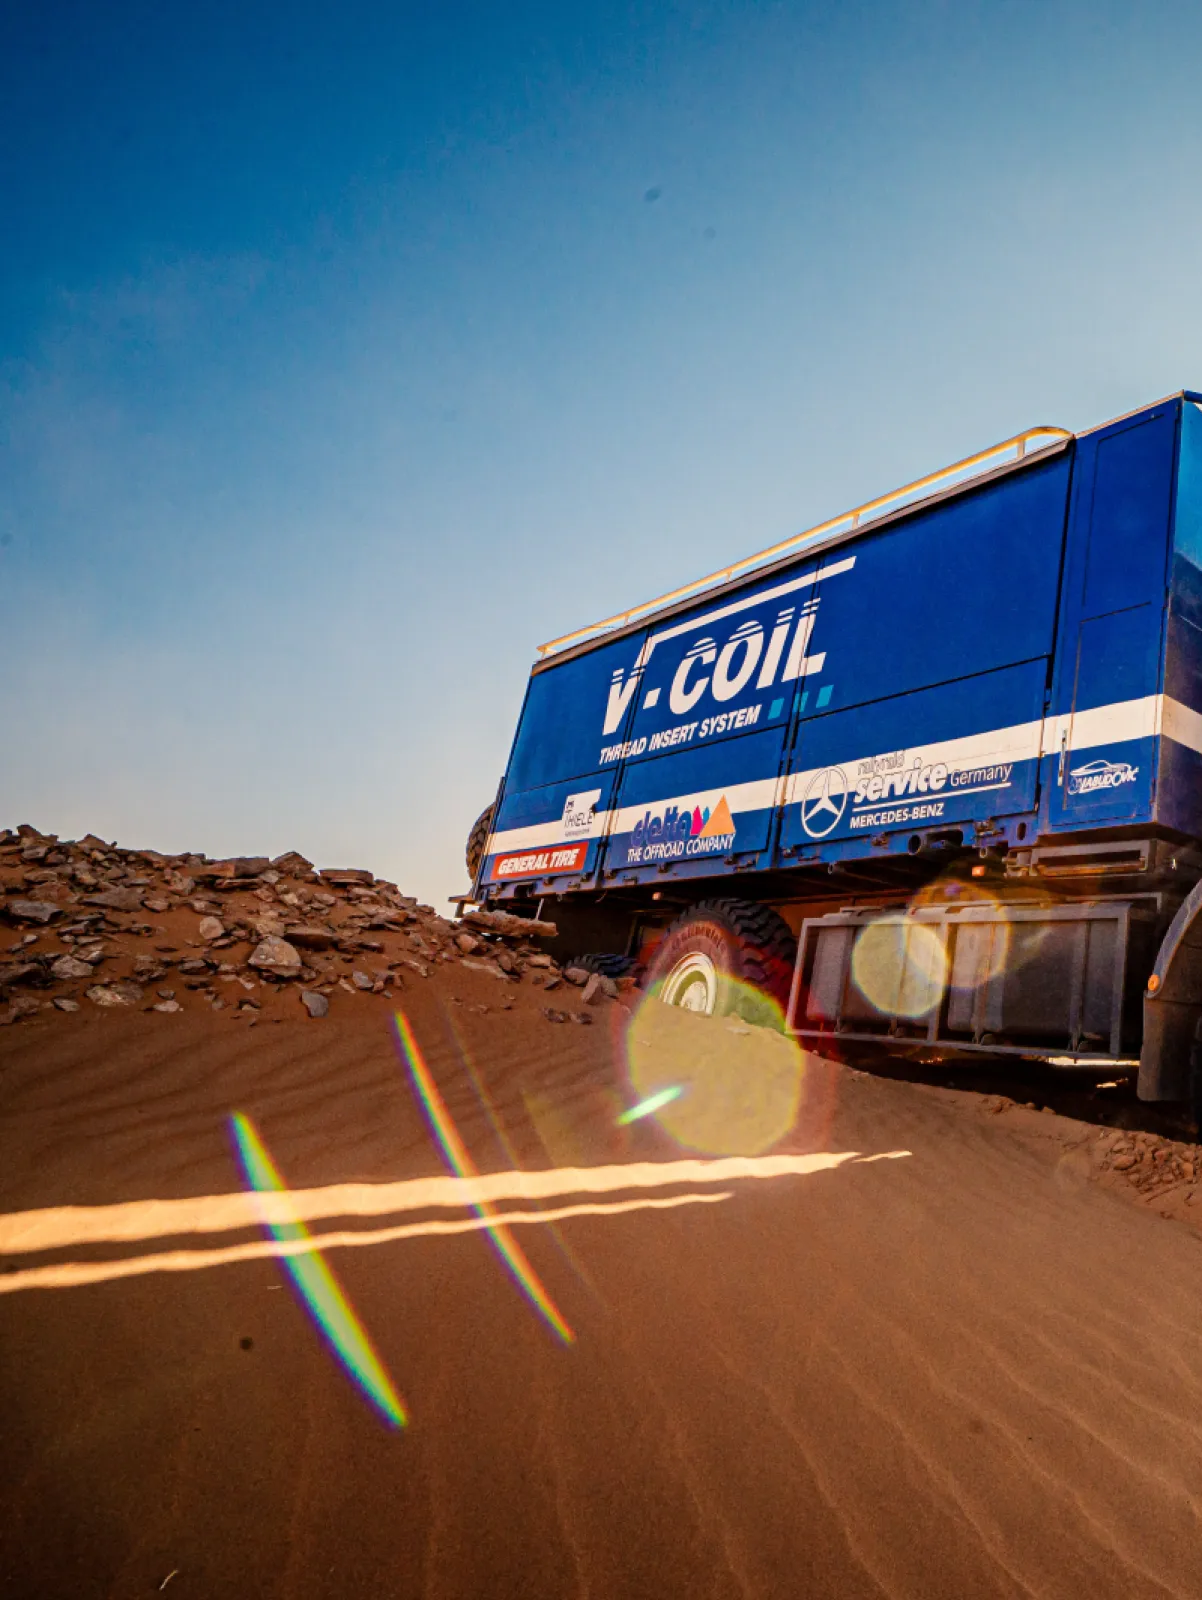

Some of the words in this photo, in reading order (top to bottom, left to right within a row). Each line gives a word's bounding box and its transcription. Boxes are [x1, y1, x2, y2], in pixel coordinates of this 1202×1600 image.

[602, 598, 827, 736] V-COIL
[598, 737, 647, 766] THREAD
[648, 721, 699, 752] INSERT
[698, 704, 763, 738] SYSTEM
[853, 756, 948, 803] service
[950, 763, 1014, 788] Germany
[631, 805, 692, 847] delta
[850, 802, 945, 830] MERCEDES-BENZ
[498, 852, 550, 875] GENERAL
[549, 848, 580, 868] TIRE
[626, 846, 644, 863] THE
[642, 839, 684, 861] OFFROAD
[686, 833, 736, 856] COMPANY
